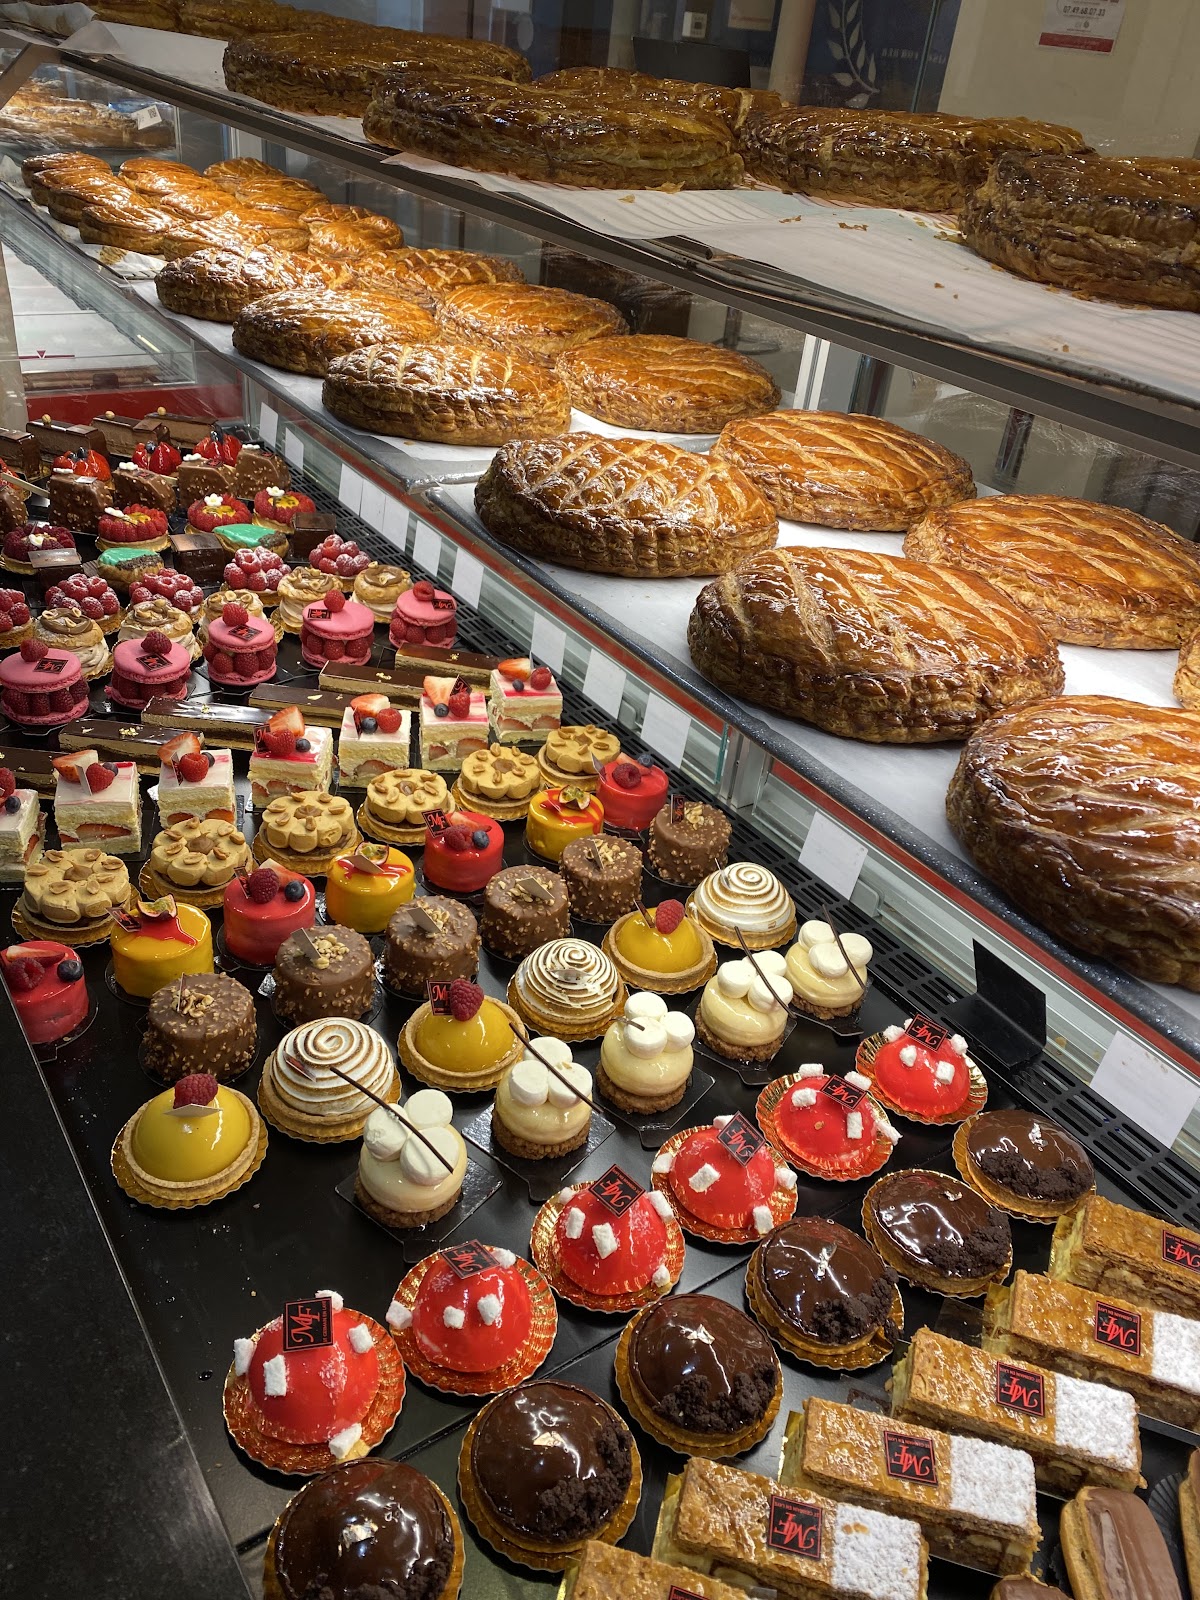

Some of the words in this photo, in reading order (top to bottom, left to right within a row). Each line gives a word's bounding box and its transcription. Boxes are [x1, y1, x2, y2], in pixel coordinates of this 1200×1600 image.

[726, 1127, 754, 1157] MF
[600, 1179, 631, 1206] MF
[289, 1305, 320, 1344] MF
[1099, 1316, 1136, 1347] MF
[1001, 1376, 1039, 1408] MF
[891, 1445, 930, 1476] MF
[774, 1512, 816, 1549] MF
